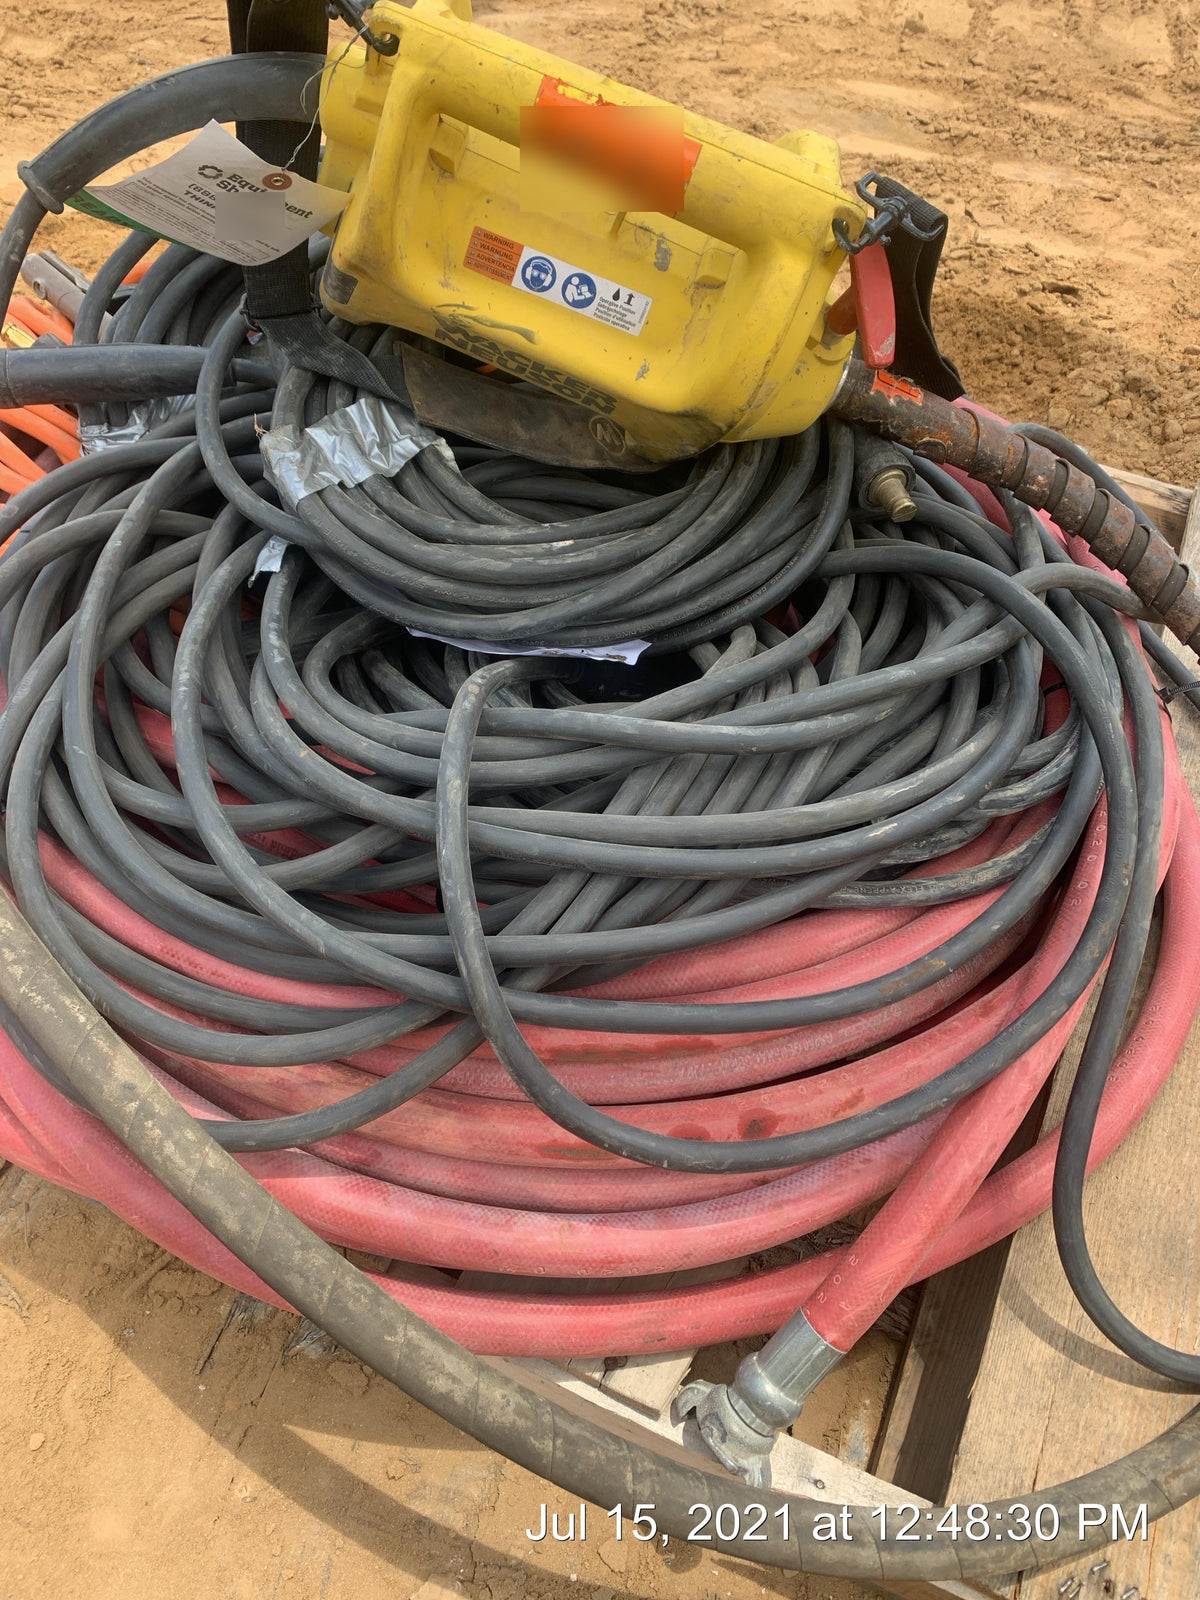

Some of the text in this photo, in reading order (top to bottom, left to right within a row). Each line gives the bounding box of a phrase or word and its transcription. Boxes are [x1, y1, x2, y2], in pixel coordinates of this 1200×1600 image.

[227, 173, 313, 218] Equient
[480, 242, 513, 260] WARNUNG
[483, 231, 514, 249] WARNING
[476, 252, 515, 272] ADVERTENCIA
[433, 308, 617, 404] WACKER
[435, 327, 616, 415] NEUSON
[767, 554, 801, 586] WELDING
[742, 583, 767, 607] CABLE
